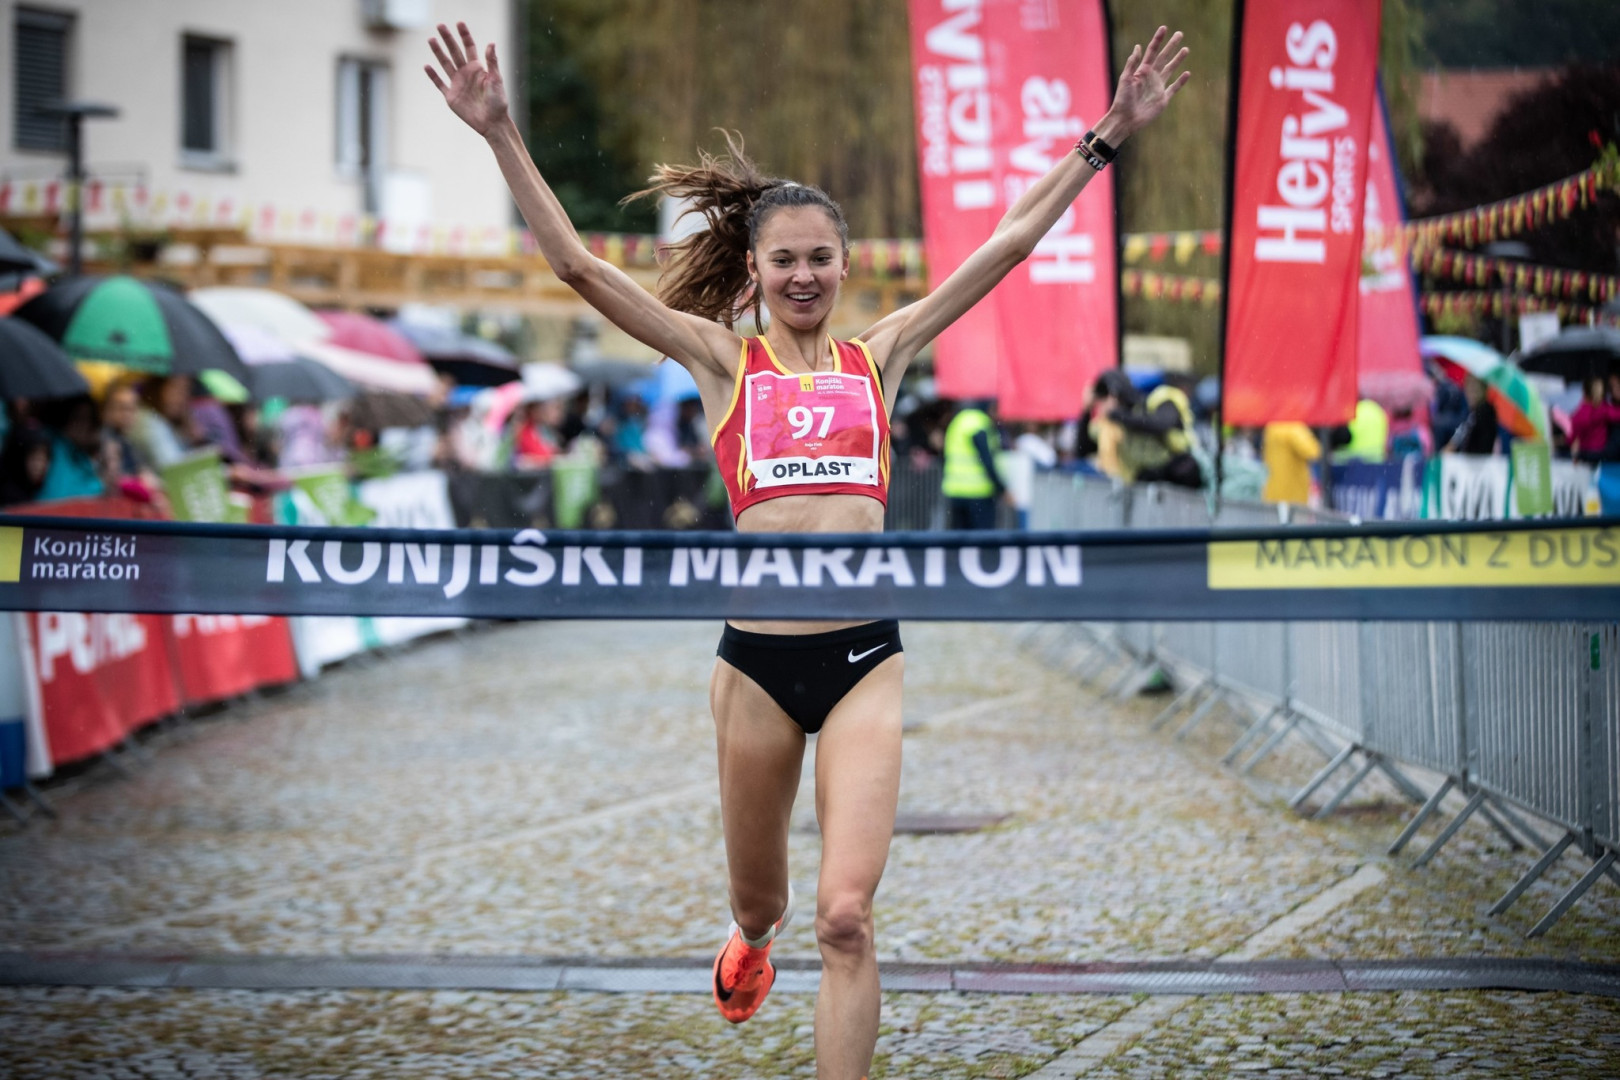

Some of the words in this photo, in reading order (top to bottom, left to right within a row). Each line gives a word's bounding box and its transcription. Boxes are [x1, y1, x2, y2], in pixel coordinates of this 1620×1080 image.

[1254, 19, 1350, 264] Hervis
[1331, 135, 1356, 235] SPORTS
[787, 406, 835, 440] 97
[772, 461, 852, 479] OPLAST
[34, 534, 137, 562] Konjiški
[1255, 533, 1469, 570] MARATON
[32, 561, 140, 580] maraton
